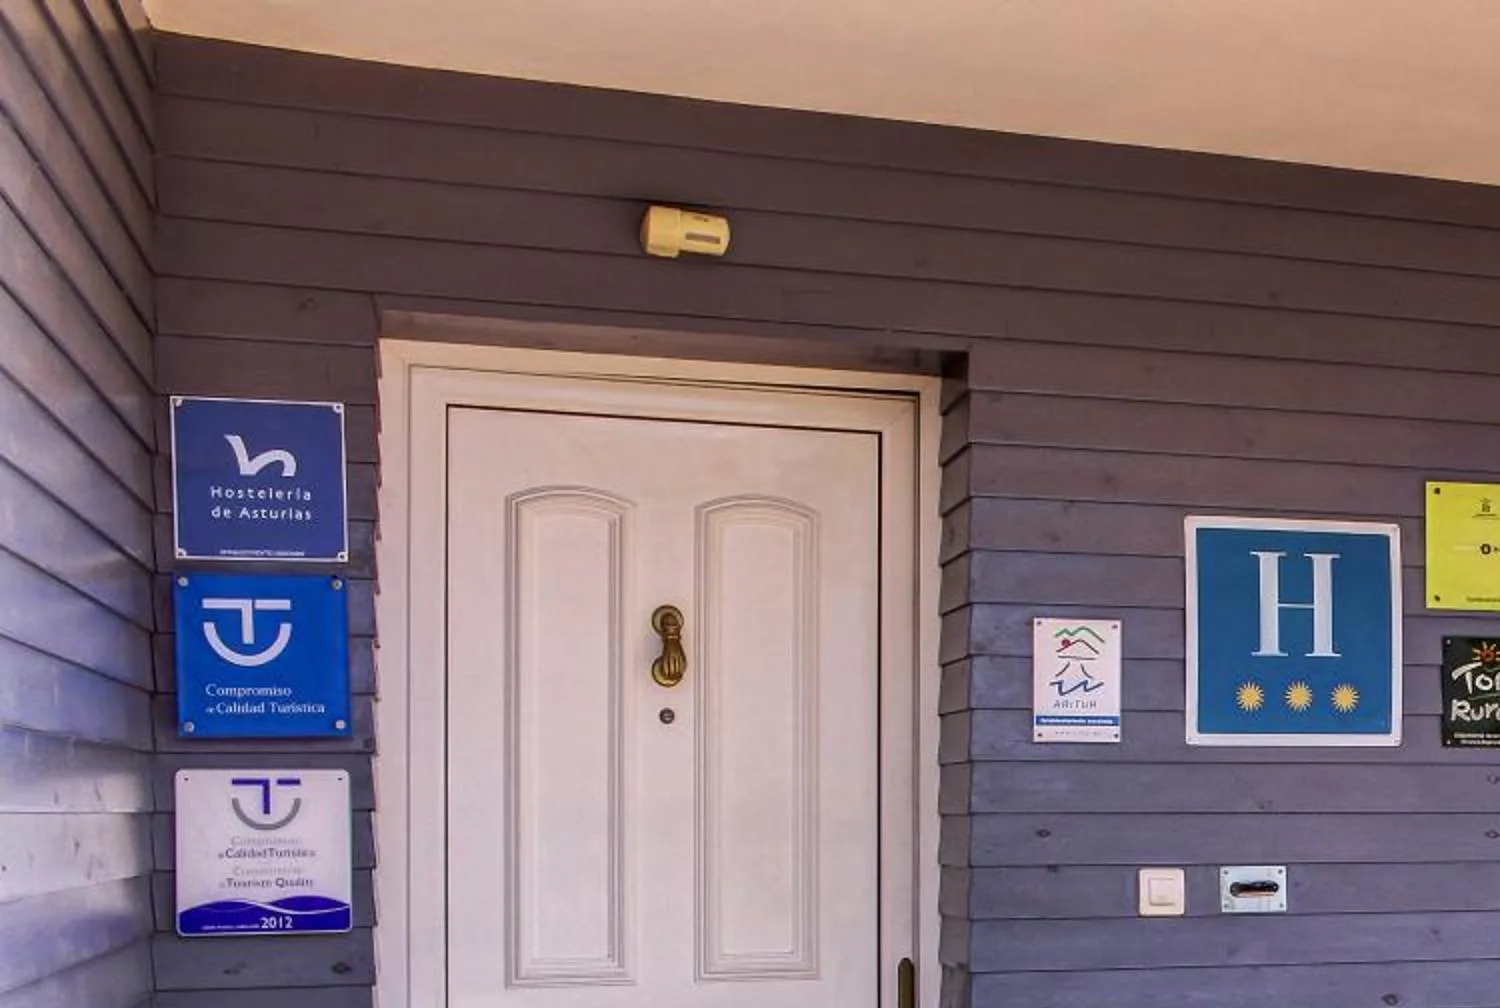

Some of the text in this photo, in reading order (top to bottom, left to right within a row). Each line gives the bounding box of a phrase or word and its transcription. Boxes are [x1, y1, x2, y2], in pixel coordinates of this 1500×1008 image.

[211, 506, 312, 521] de Asturias
[1250, 551, 1342, 657] H
[205, 683, 293, 698] Compromiso
[216, 701, 265, 715] Calidad
[269, 701, 326, 714] Turística
[260, 916, 294, 930] 2012
